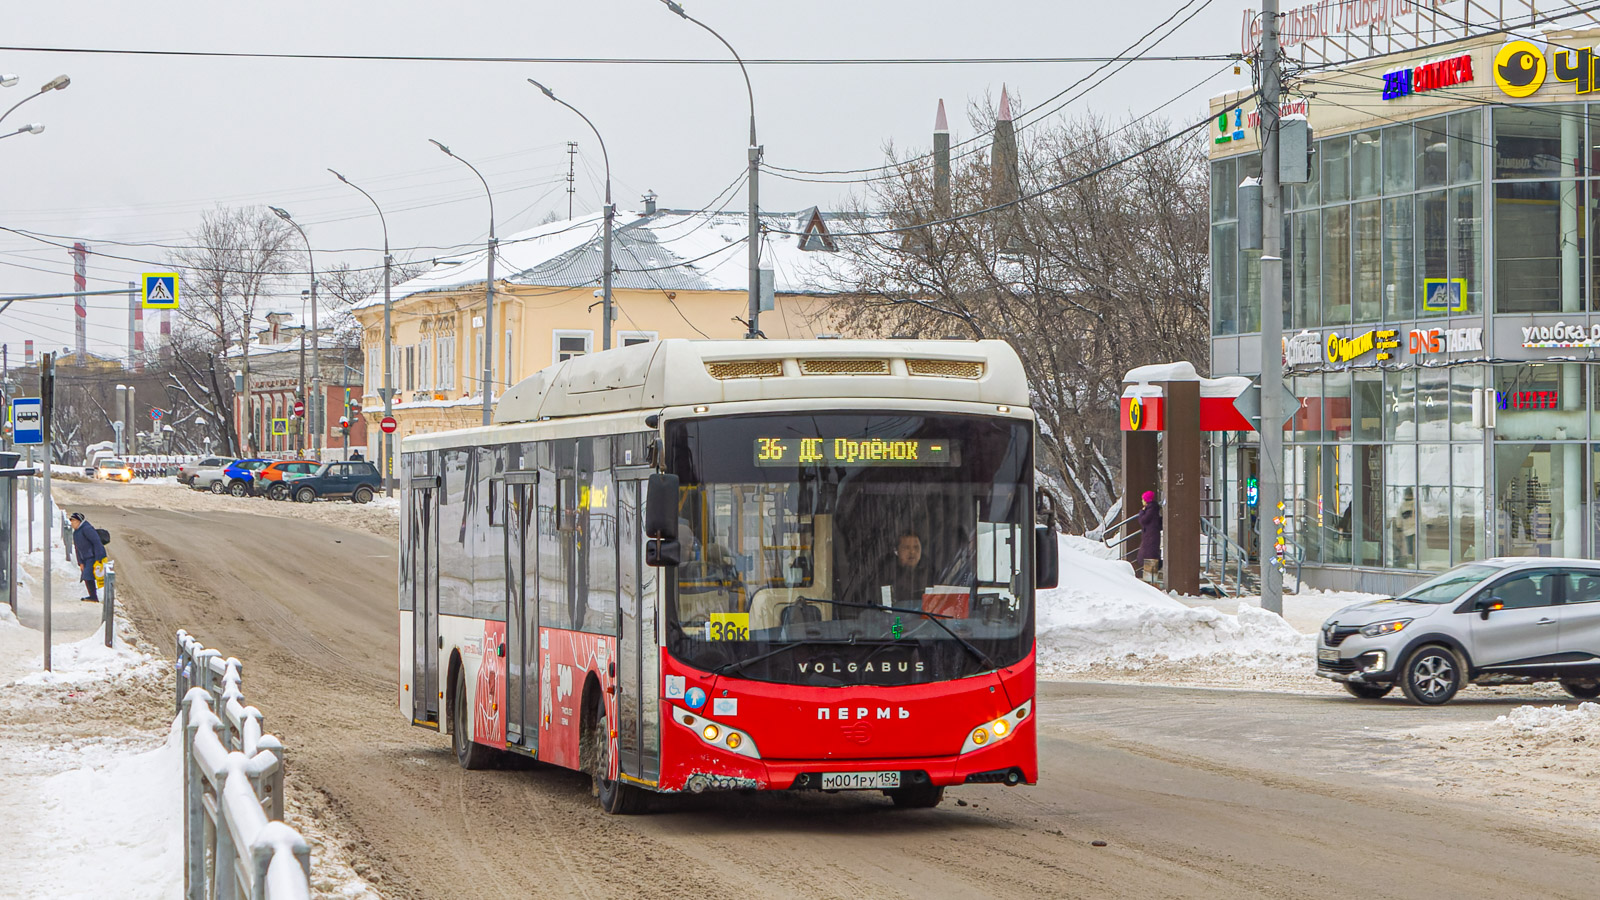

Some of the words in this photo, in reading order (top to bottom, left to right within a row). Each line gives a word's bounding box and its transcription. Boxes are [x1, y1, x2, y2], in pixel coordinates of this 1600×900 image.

[1382, 69, 1410, 101] ZEN
[1413, 54, 1474, 93] ОПТИКА
[1553, 46, 1600, 94] Ч
[1409, 329, 1440, 354] DNS
[1444, 328, 1482, 353] ТАБАК
[798, 438, 824, 463] ДС
[834, 438, 918, 463] Орлёнок
[711, 621, 748, 641] 36к
[798, 661, 925, 673] VOLGABUS
[817, 706, 910, 720] ПЕРМЬ
[826, 774, 875, 788] М001РУ
[878, 772, 897, 783] 159
